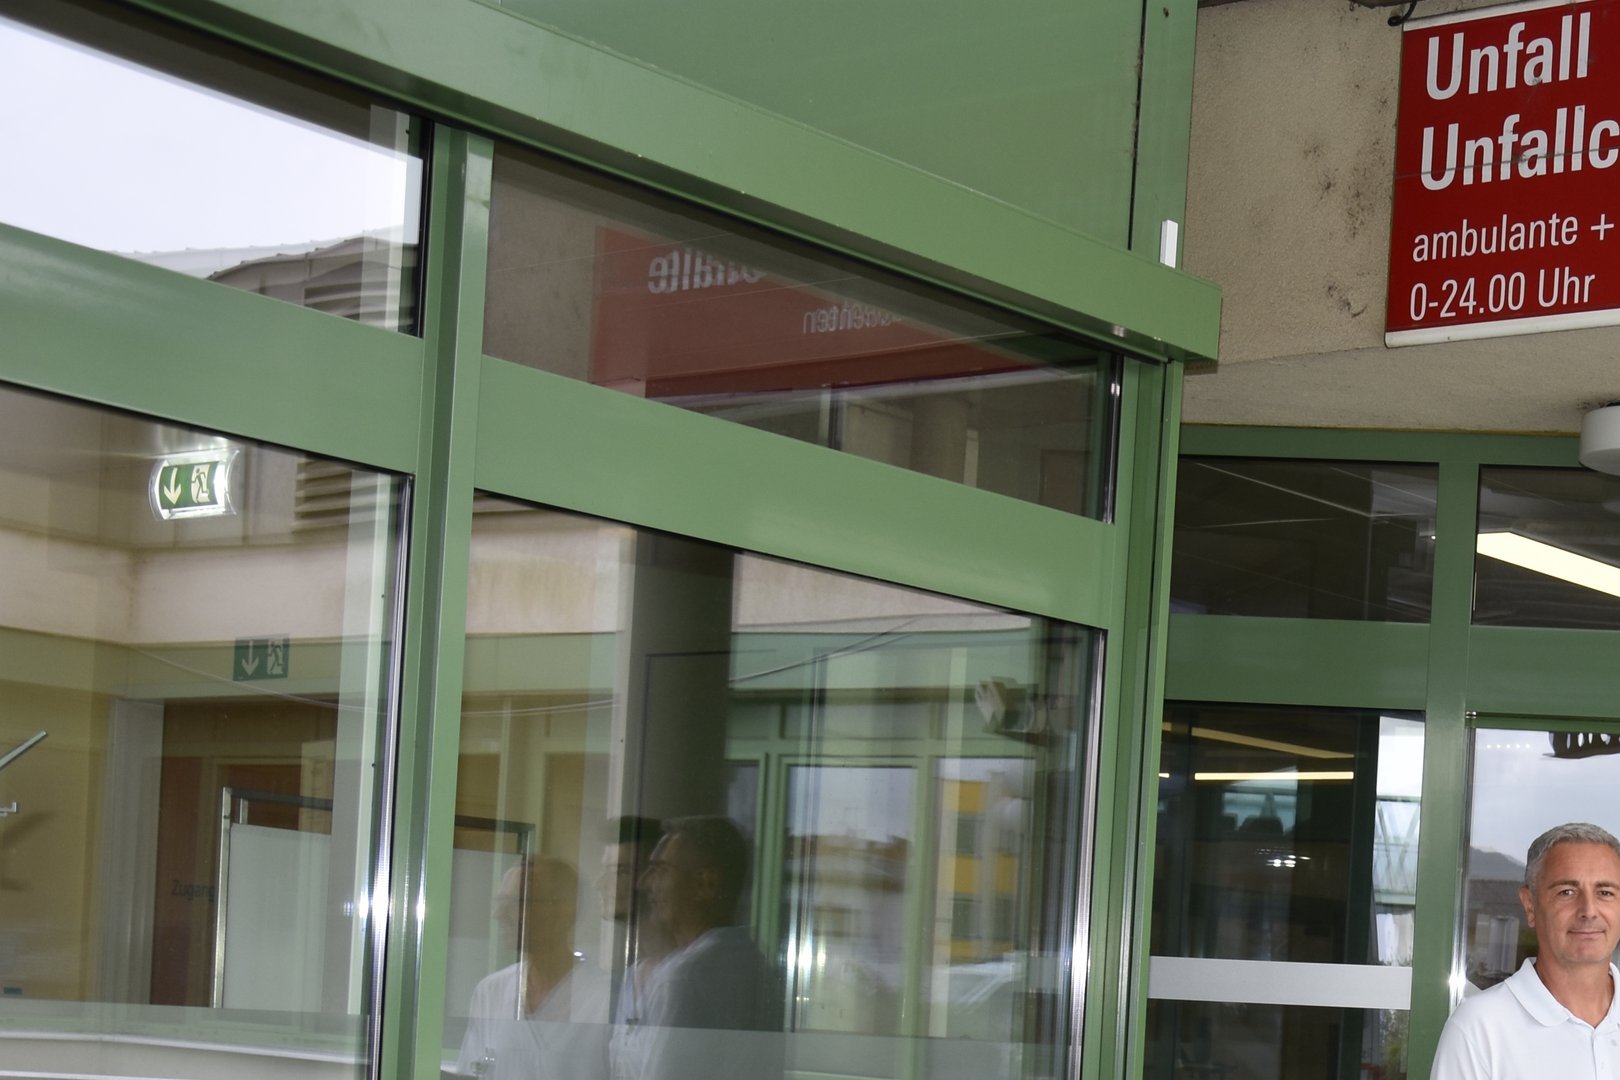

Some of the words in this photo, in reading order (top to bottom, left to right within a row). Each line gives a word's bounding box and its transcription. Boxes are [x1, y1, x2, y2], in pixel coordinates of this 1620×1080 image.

[1426, 11, 1591, 100] Unfall
[1412, 213, 1578, 262] ambulante
[1590, 213, 1615, 241] +
[1410, 271, 1526, 321] 0-24.00
[1538, 266, 1596, 308] Uhr
